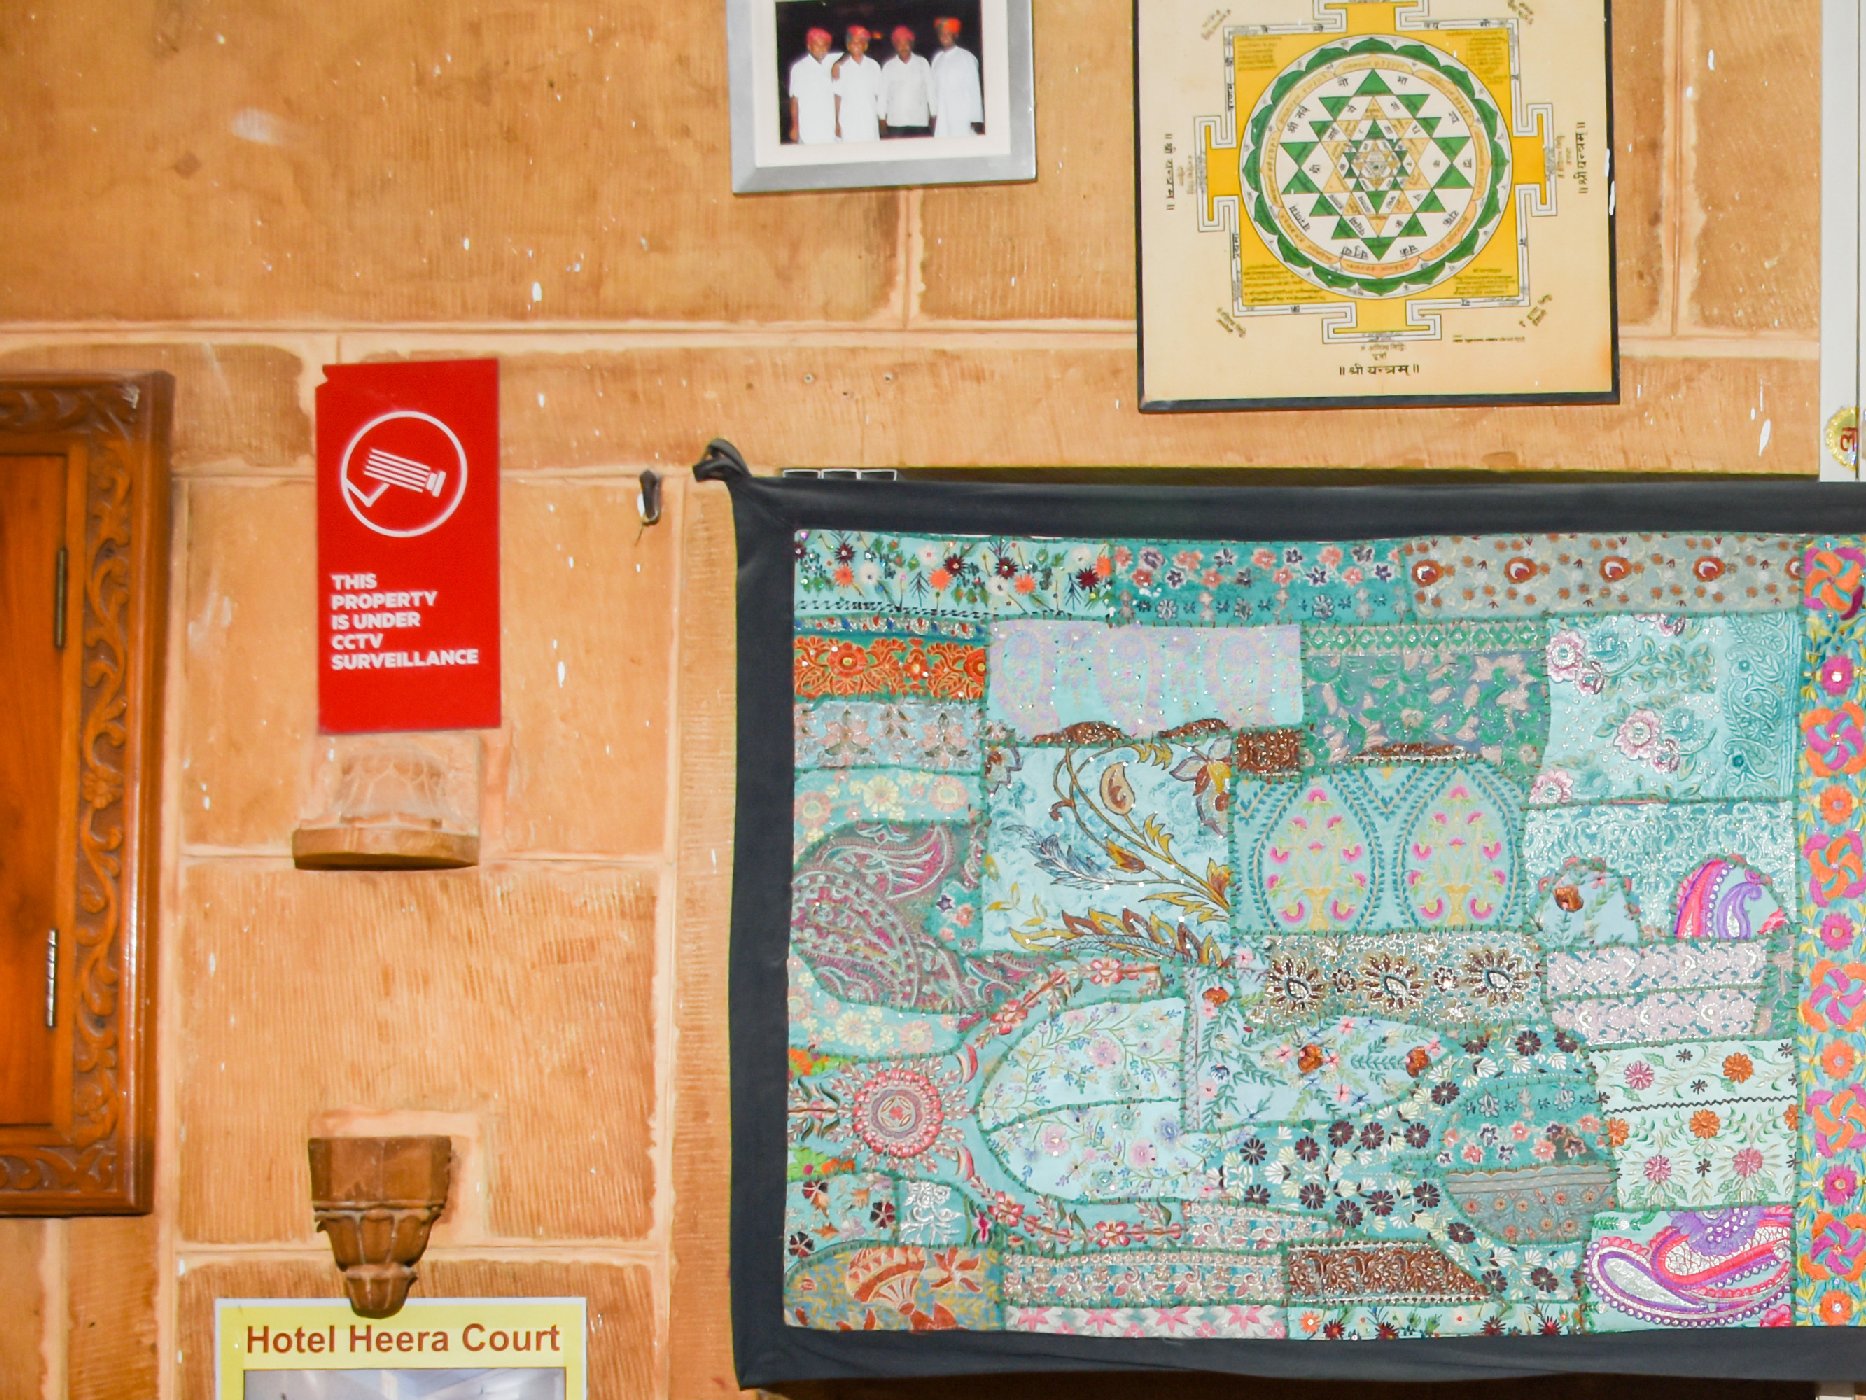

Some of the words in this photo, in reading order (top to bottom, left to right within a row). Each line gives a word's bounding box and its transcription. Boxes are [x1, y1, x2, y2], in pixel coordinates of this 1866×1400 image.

[330, 573, 377, 590] THIS
[331, 591, 437, 610] PROPERTY
[331, 613, 348, 630] IS
[353, 611, 421, 629] UNDER
[331, 632, 383, 650] CCTV
[331, 648, 480, 670] SURVEILLANCE
[247, 1325, 335, 1354] Hotel
[349, 1324, 449, 1353] Heera
[461, 1323, 560, 1353] Court
